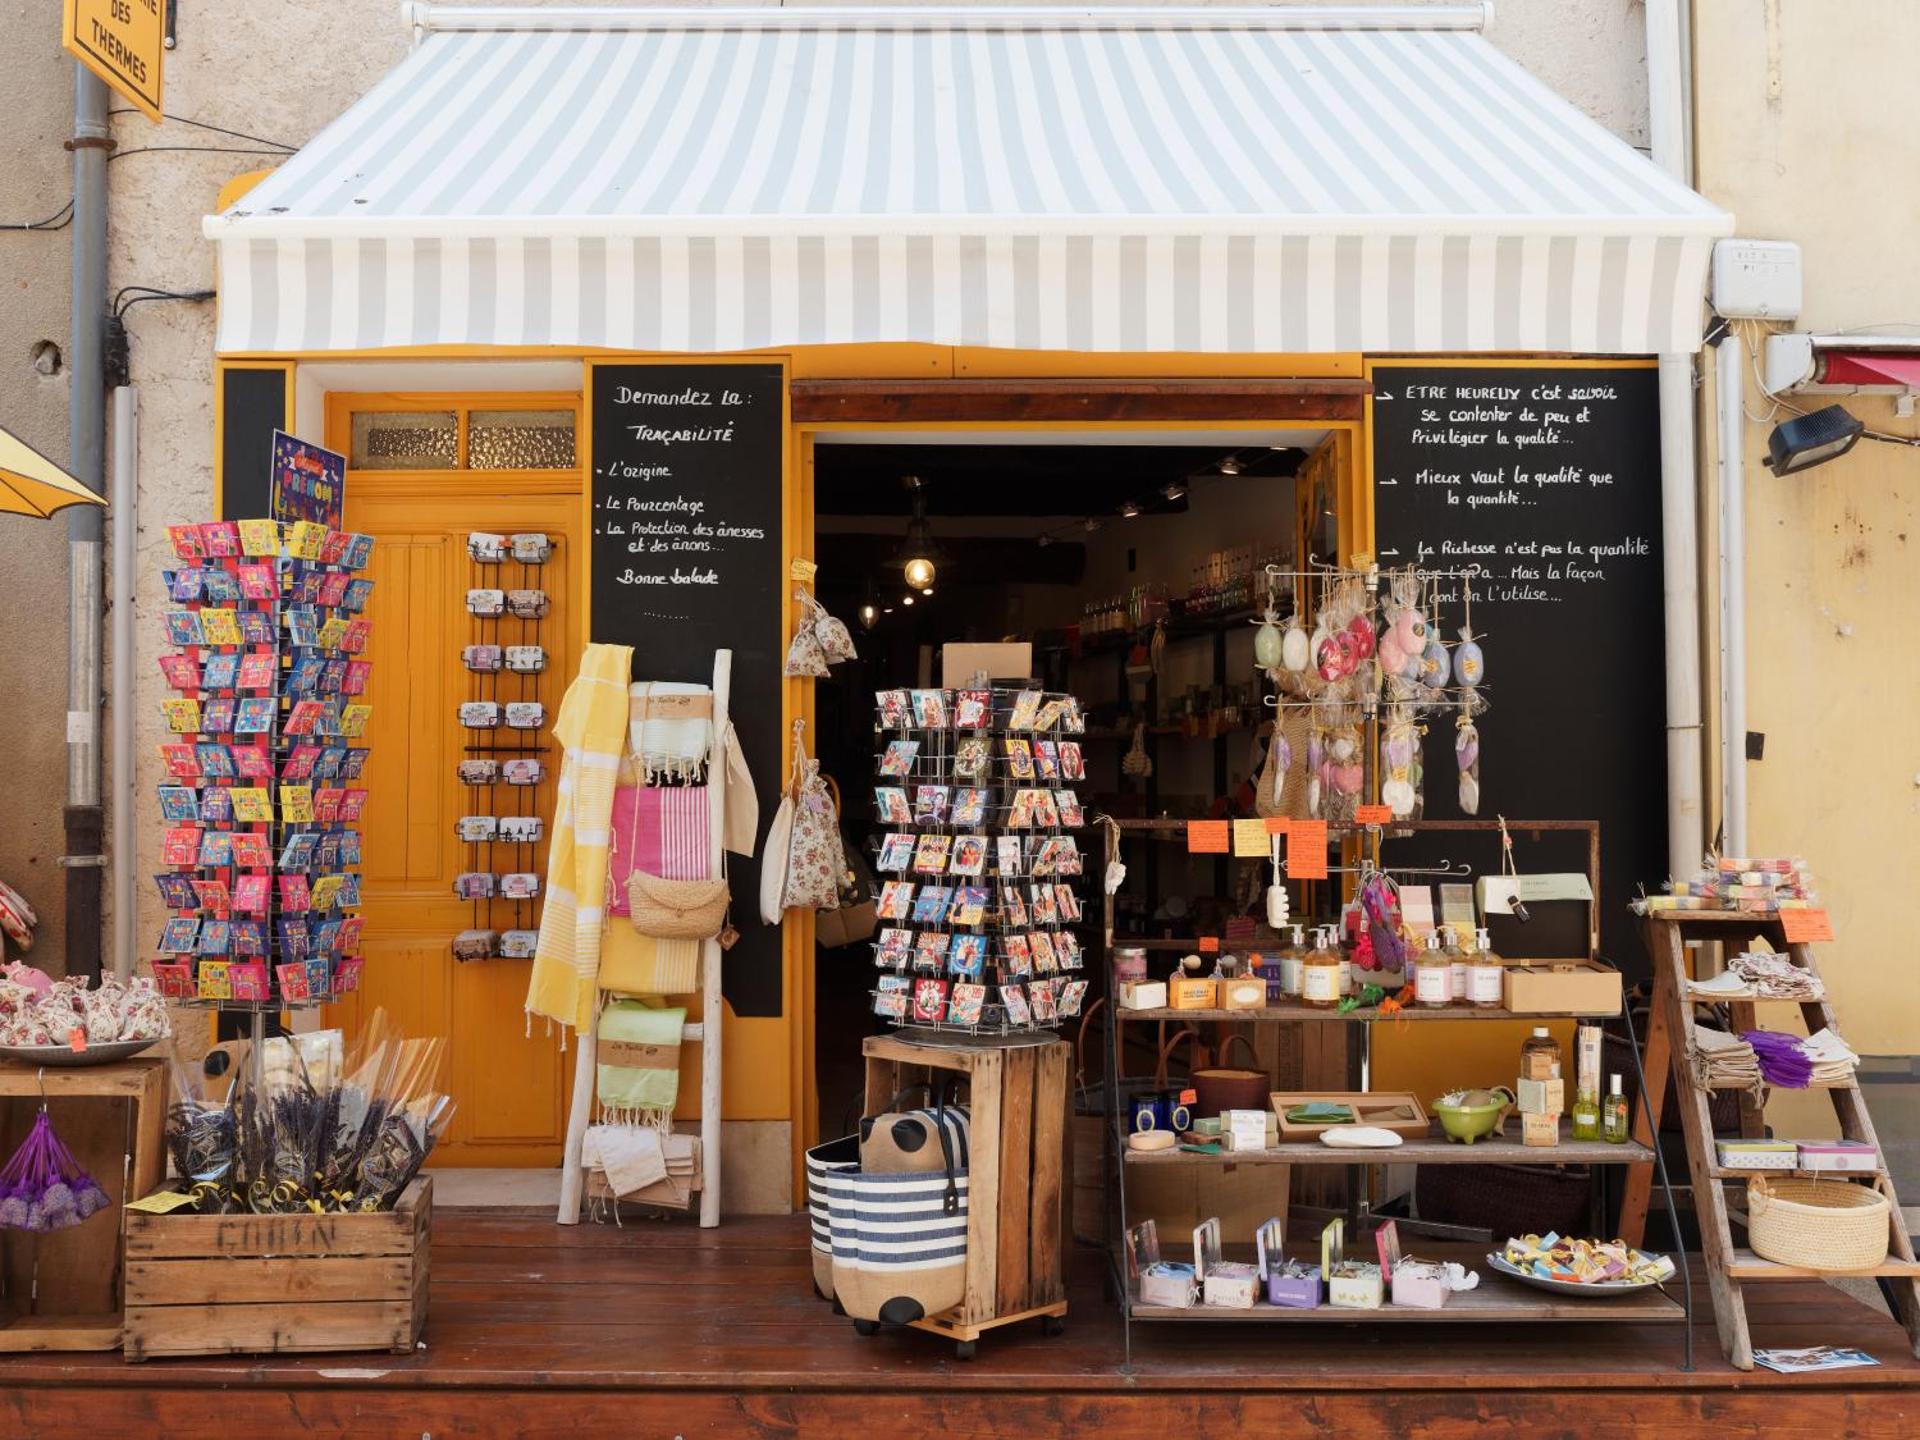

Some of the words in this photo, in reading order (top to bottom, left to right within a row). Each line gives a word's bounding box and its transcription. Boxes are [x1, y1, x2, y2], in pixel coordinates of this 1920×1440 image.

[110, 0, 131, 24] DES
[91, 16, 147, 84] THERMES
[614, 386, 712, 405] Demandez
[1406, 385, 1447, 399] ETRE
[1456, 387, 1520, 400] HEUREUX
[1519, 407, 1538, 421] de
[1544, 412, 1570, 430] peu
[1576, 406, 1590, 423] et
[1497, 430, 1509, 444] la
[1416, 469, 1461, 484] Mieux
[1514, 465, 1529, 483] la
[1534, 466, 1582, 488] qualité
[1589, 473, 1613, 487] que
[606, 496, 620, 509] Le
[627, 495, 704, 516] Pourcentage
[1448, 489, 1459, 504] la
[607, 521, 625, 534] La
[693, 522, 713, 536] des
[717, 522, 764, 539] ânesses
[628, 537, 645, 553] et
[650, 539, 668, 552] des
[1442, 540, 1496, 554] Richesse
[1505, 541, 1537, 554] n'est
[1541, 545, 1562, 557] pas
[1568, 541, 1584, 555] la
[1589, 536, 1648, 563] quantité
[616, 568, 668, 584] Bonne
[669, 567, 718, 584] balade
[1511, 565, 1539, 579] Mais
[1547, 563, 1560, 579] la
[1566, 560, 1605, 582] façon
